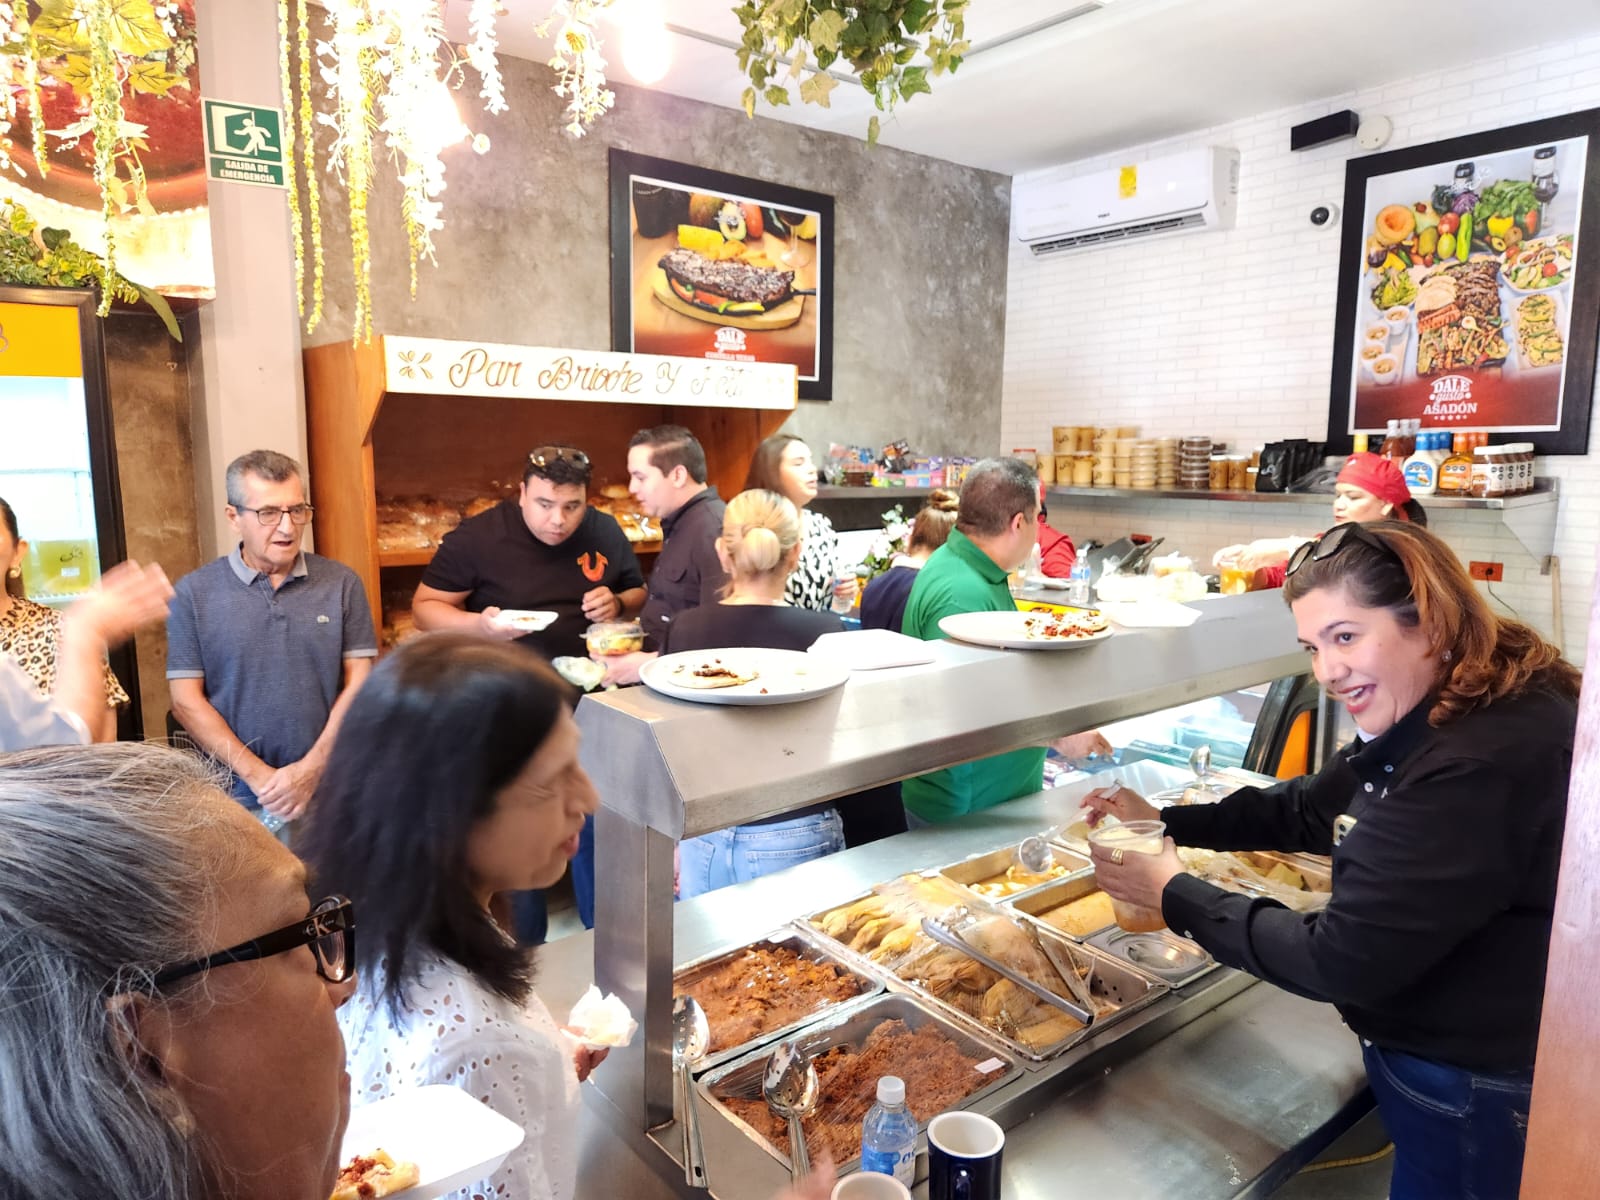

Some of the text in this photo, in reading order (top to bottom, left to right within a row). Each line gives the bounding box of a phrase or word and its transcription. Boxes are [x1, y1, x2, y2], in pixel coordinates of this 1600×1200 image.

[224, 160, 269, 173] SALIDA DE
[220, 169, 276, 183] EMERGENCIA
[449, 348, 522, 389] Pan
[538, 356, 643, 394] Brioche
[1433, 378, 1470, 393] DALE
[1423, 401, 1478, 415] ASADÓN
